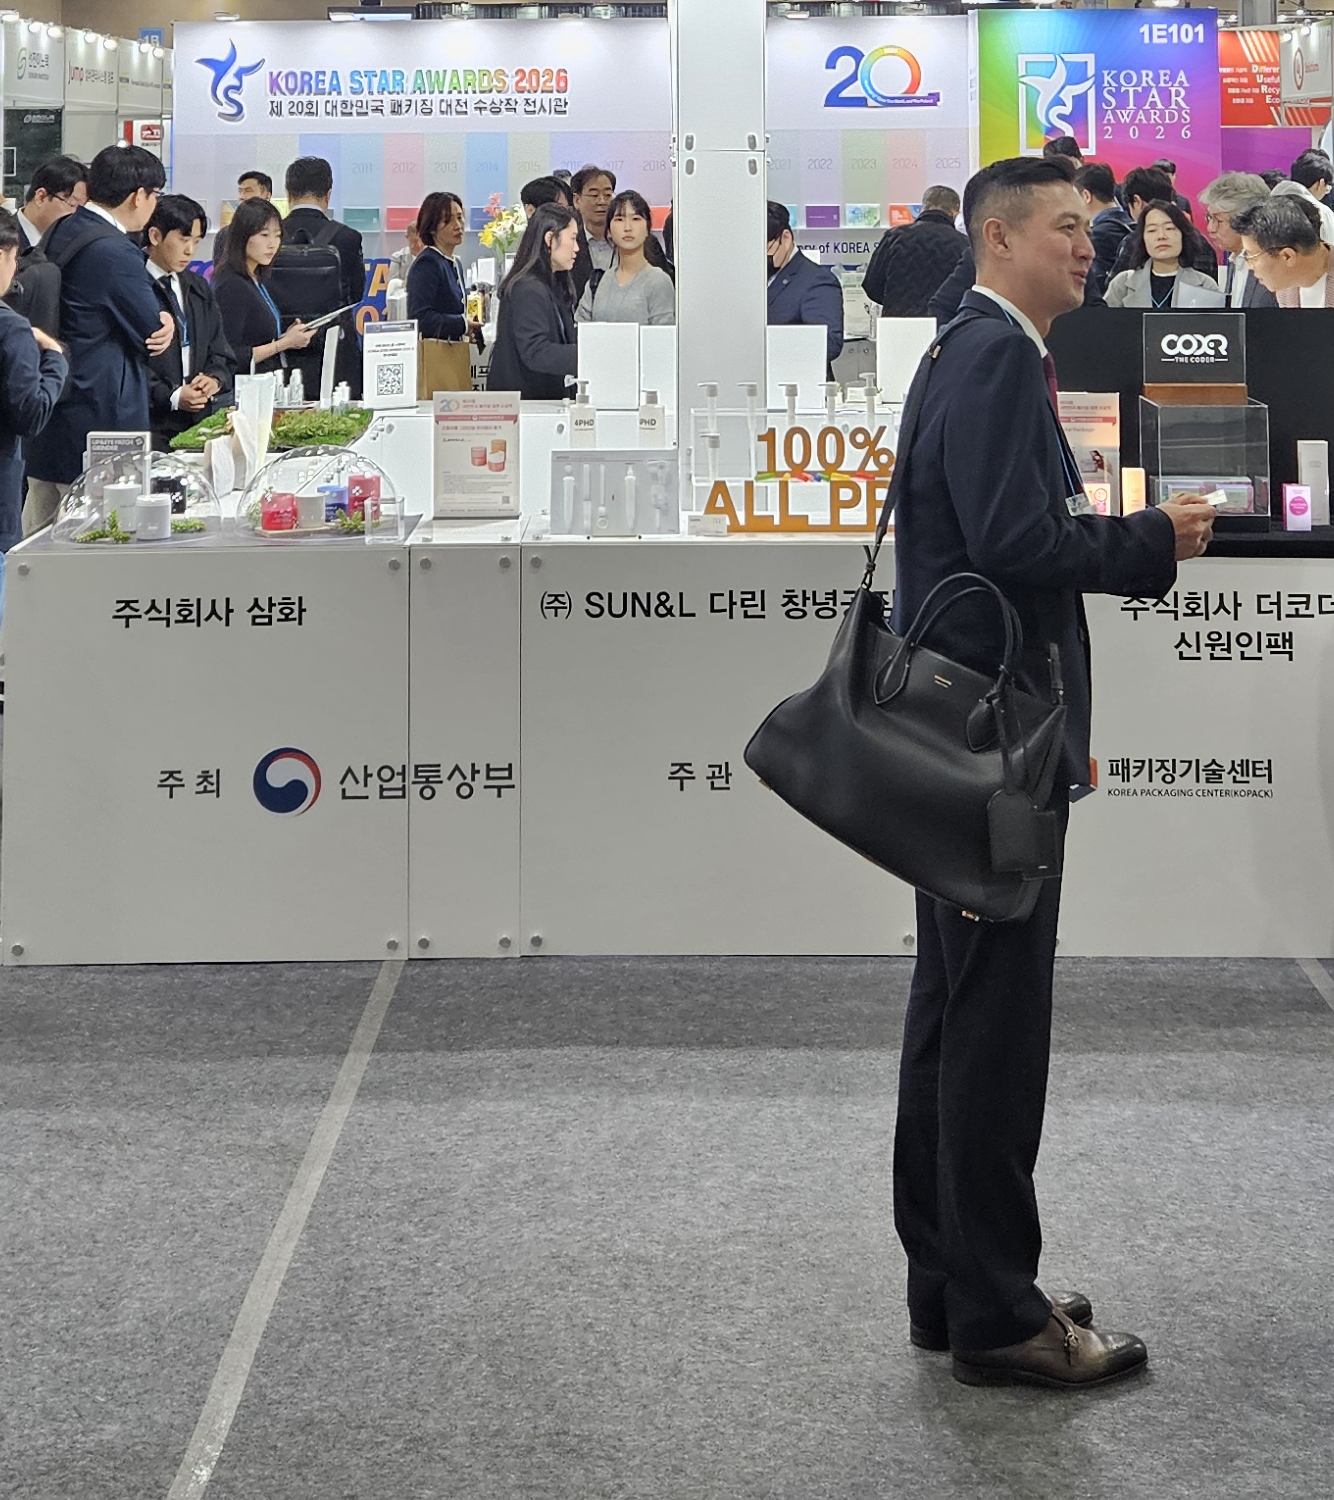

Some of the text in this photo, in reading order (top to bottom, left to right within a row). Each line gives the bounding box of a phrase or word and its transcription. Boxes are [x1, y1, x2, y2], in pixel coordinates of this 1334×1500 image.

[1139, 23, 1205, 44] 1E101
[268, 68, 569, 97] KOREA STAR AWARDS 2026
[1101, 69, 1190, 87] KOREA
[1101, 86, 1190, 110] STAR
[268, 97, 569, 117] 제 20회 대한민국 패키징 대전 수상작 전시관
[1102, 109, 1191, 124] AWARDS
[392, 161, 416, 174] 2012
[433, 161, 458, 174] 2013
[475, 161, 499, 173] 2014
[516, 160, 541, 173] 2015
[641, 160, 666, 172] 2018
[807, 159, 834, 170] 2022
[850, 158, 877, 170] 2023
[892, 158, 917, 170] 2024
[935, 158, 962, 169] 2025
[819, 242, 871, 254] of KOREA
[574, 419, 595, 427] 4PHD
[757, 425, 896, 474] 100%
[703, 480, 810, 530] ALL
[112, 595, 307, 629] 주식회사 삼화
[540, 590, 768, 620] (주) SUN&L 다린
[1120, 590, 1243, 621] 주식회사
[1173, 630, 1295, 662] 신원인팩
[1107, 757, 1274, 785] 패키징기술센터
[338, 762, 516, 801] 산업통상부
[1107, 788, 1274, 799] KOREA PACKAGING CENTER(KOPACK)
